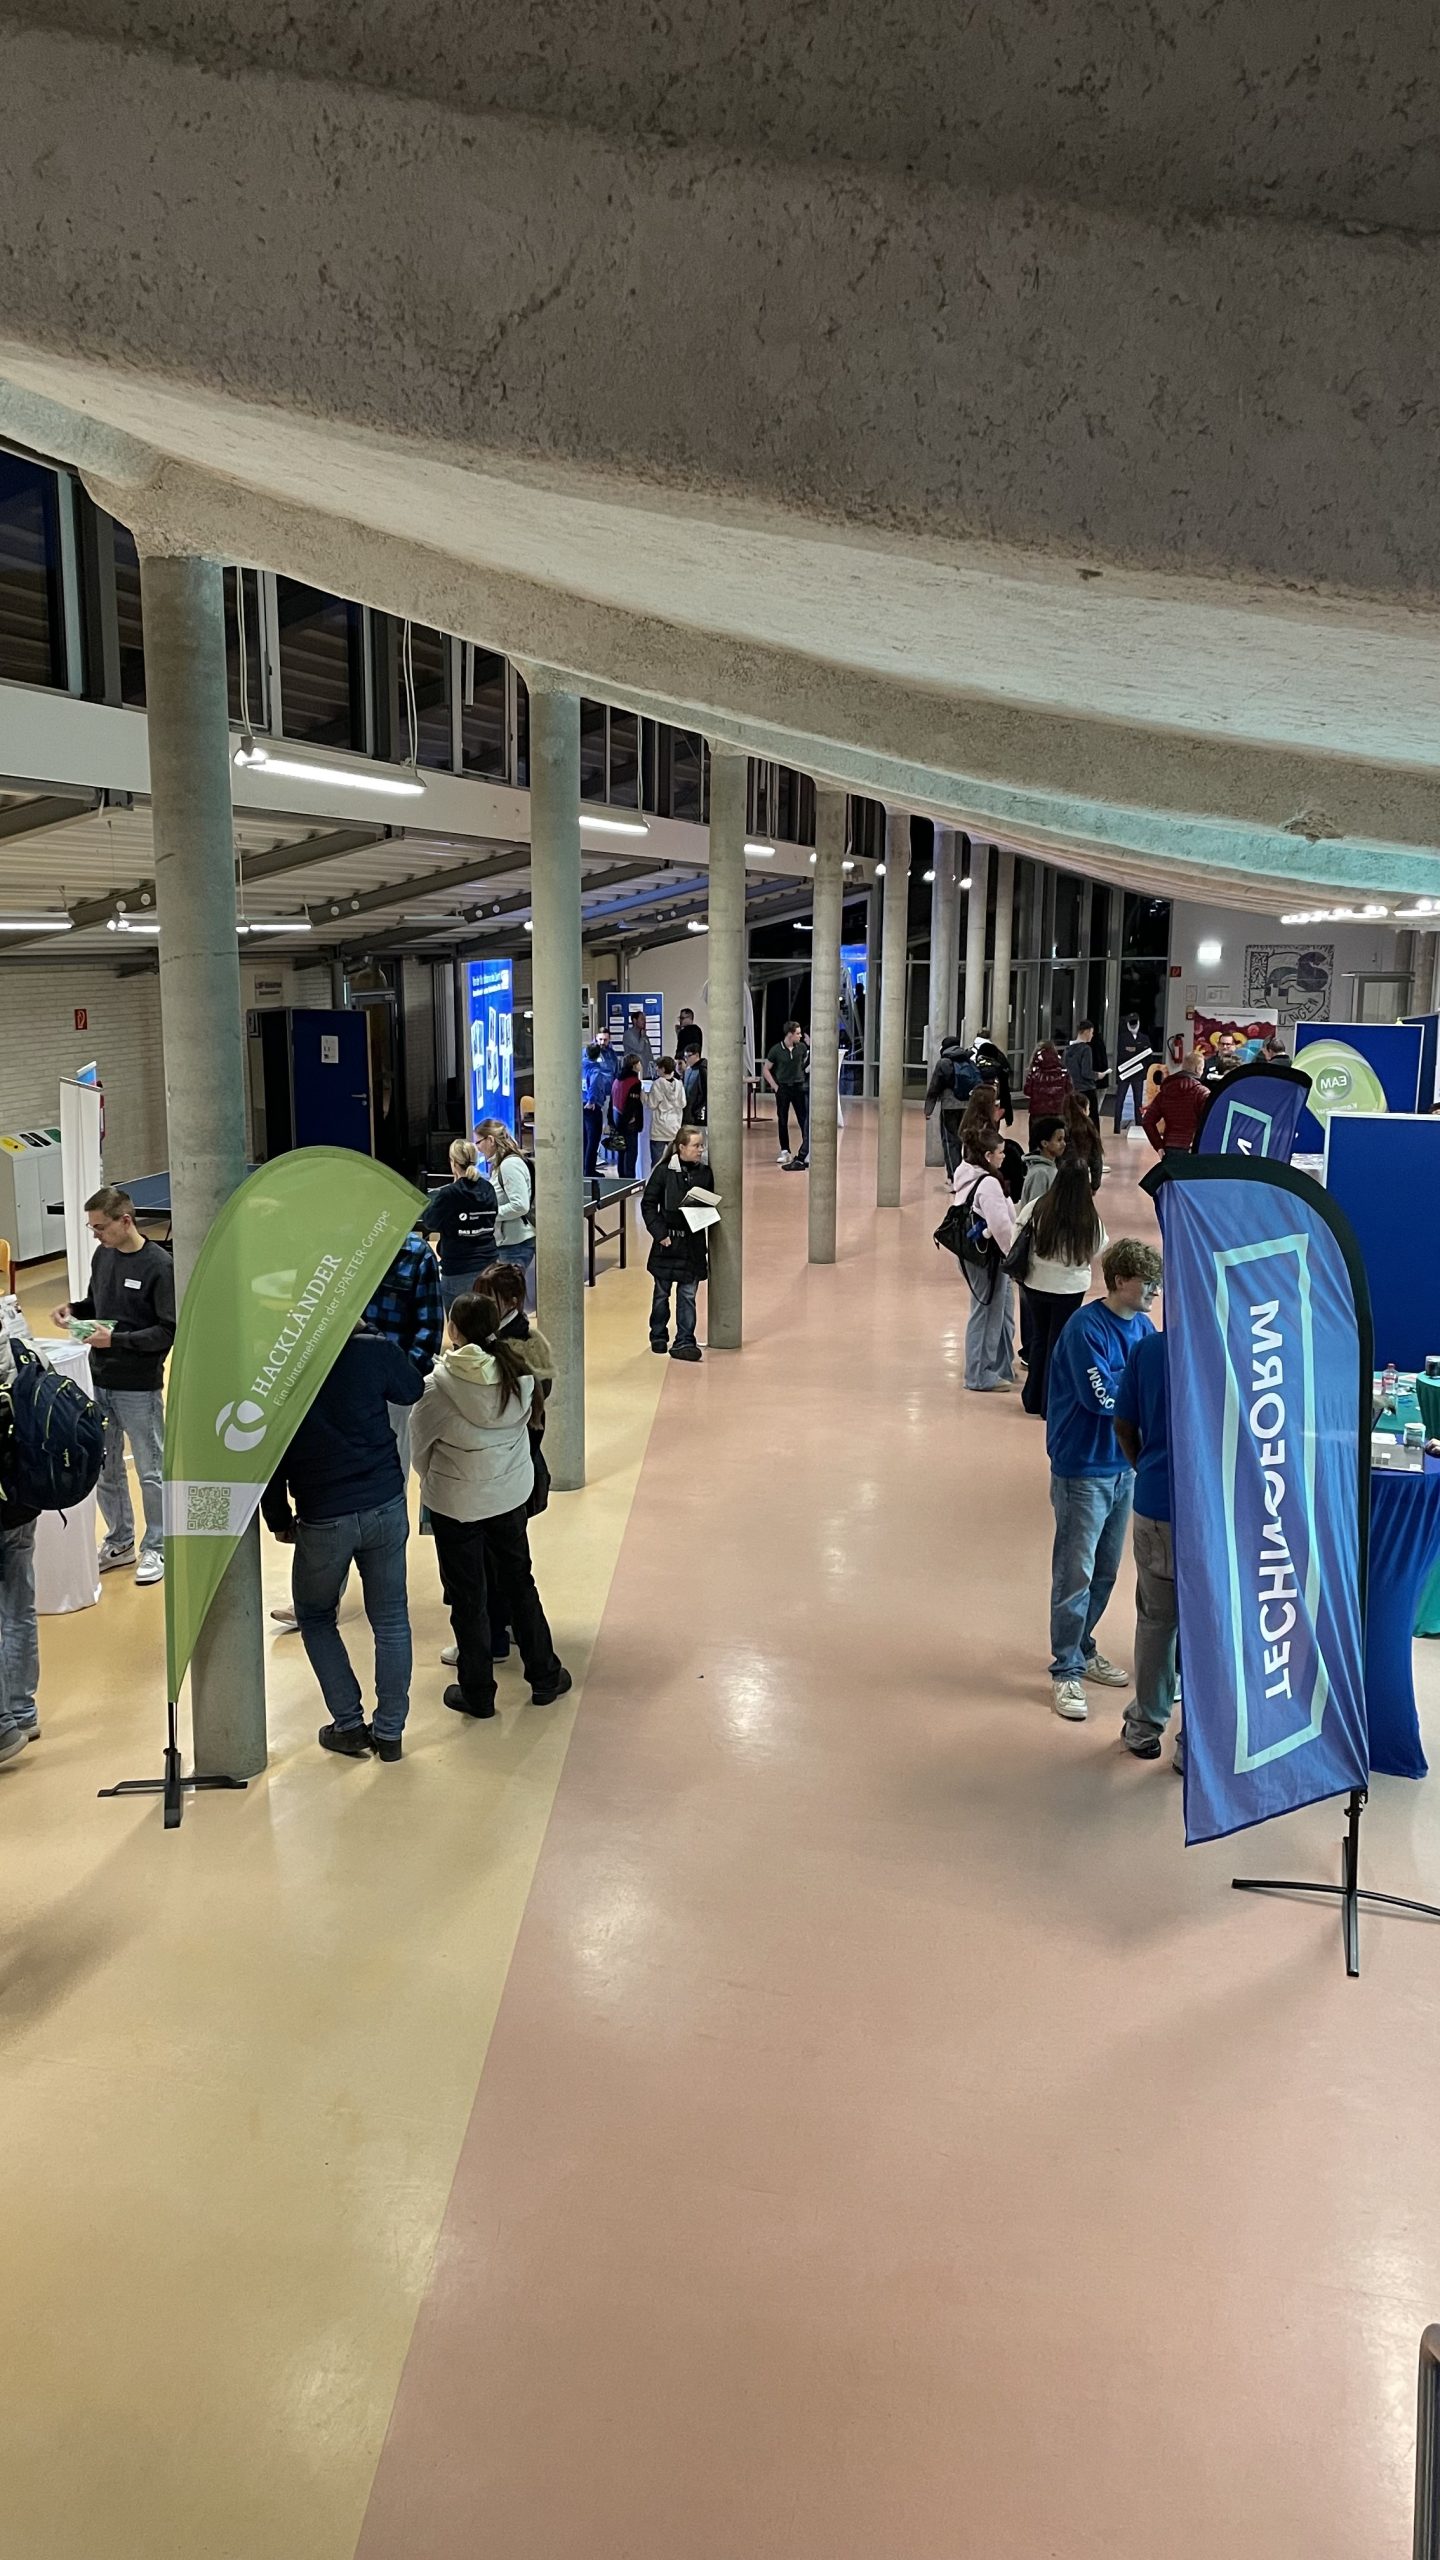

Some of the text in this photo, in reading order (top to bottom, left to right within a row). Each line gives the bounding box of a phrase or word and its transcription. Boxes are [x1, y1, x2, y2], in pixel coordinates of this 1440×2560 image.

[251, 1254, 343, 1397] HACKLÄNDER
[273, 1388, 288, 1407] Ein
[284, 1317, 330, 1390] Unternehmen
[324, 1297, 340, 1316] der
